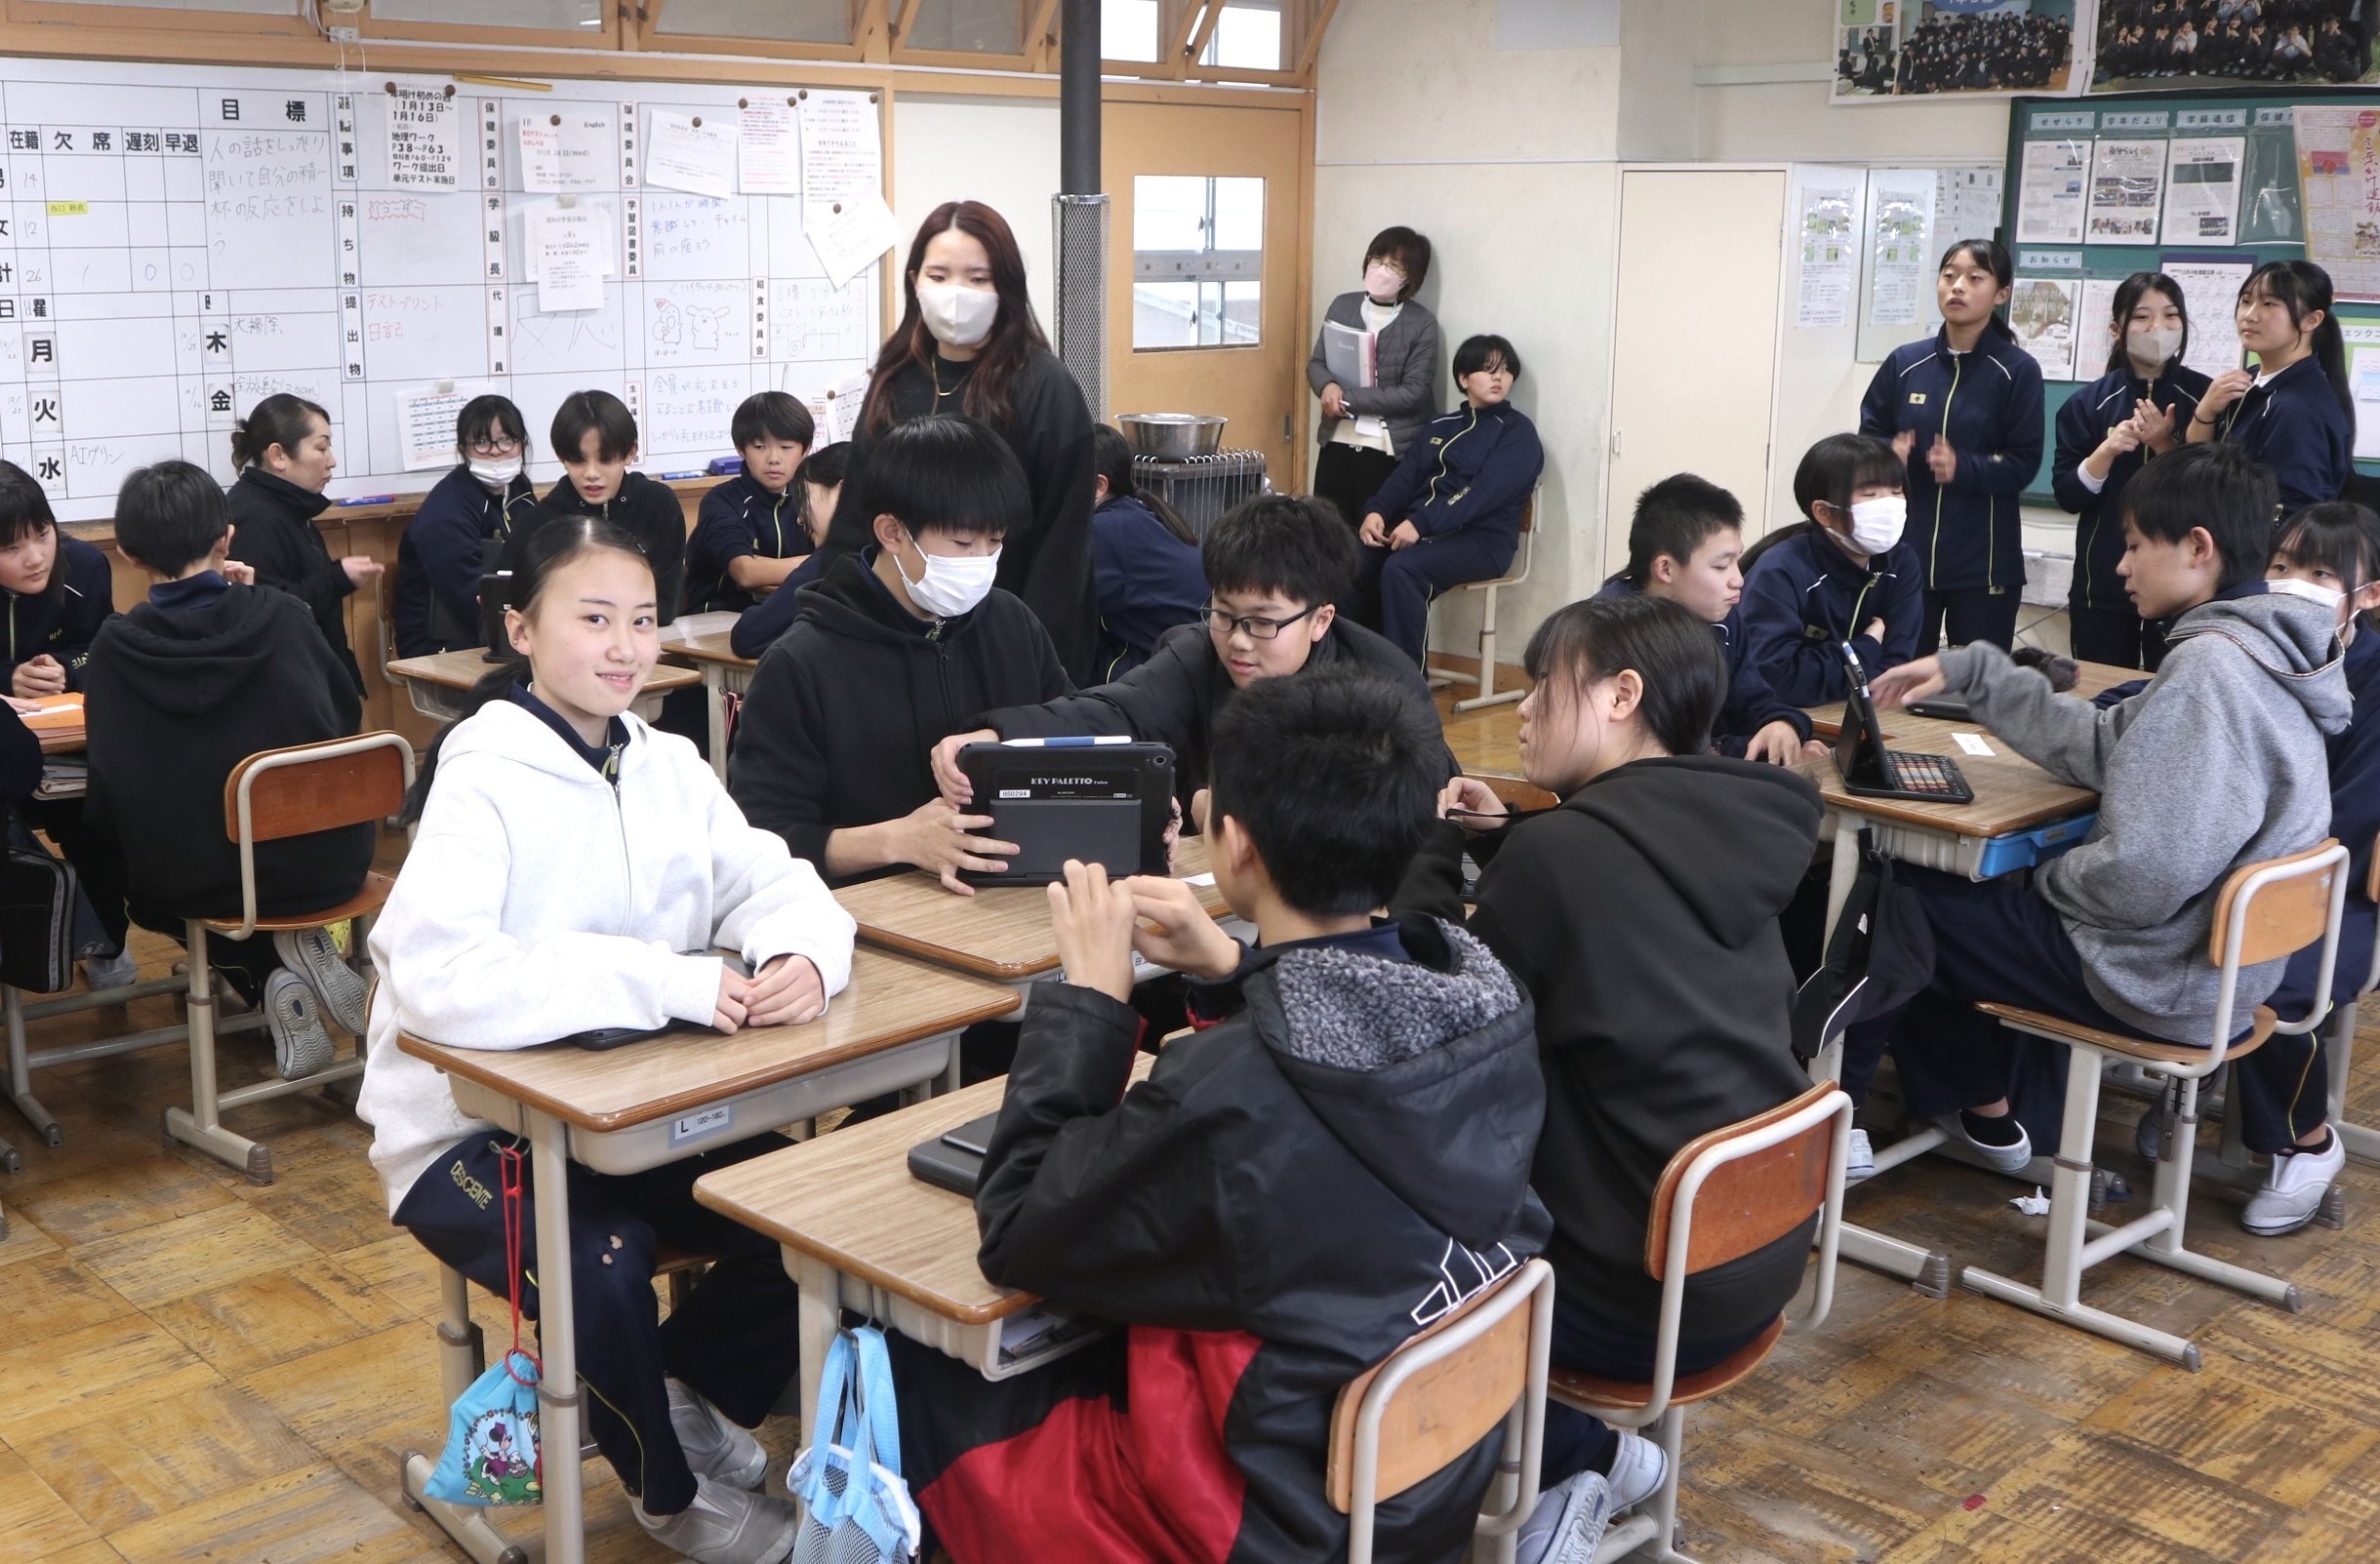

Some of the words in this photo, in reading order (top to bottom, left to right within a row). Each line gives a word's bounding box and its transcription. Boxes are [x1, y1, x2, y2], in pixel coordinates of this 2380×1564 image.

[222, 99, 305, 122] 目標
[2107, 114, 2163, 126] 学年だより
[2187, 113, 2237, 125] 学級通信
[584, 121, 606, 130] English
[2039, 117, 2084, 128] せせらぎ
[10, 130, 40, 150] 在籍
[54, 131, 111, 151] 欠席
[125, 132, 160, 153] 遅刻
[165, 133, 199, 153] 早退
[391, 132, 435, 142] 地理ワーク
[484, 102, 497, 186] 保健委員会
[623, 104, 634, 185] 環境委員会
[392, 162, 446, 173] ワーク提出日
[24, 173, 37, 188] 14
[24, 220, 37, 238] 12
[489, 198, 501, 276] 学級長
[627, 200, 637, 276] 学習図書委員
[341, 204, 356, 286] 持ち物
[2030, 255, 2072, 265] お知らせ
[26, 266, 42, 283] 26
[366, 293, 445, 312] テストプリント
[755, 279, 765, 355] 給食委員会
[344, 296, 361, 377] 提出物
[369, 321, 403, 342] 日記
[492, 290, 504, 372] 代議員
[30, 339, 54, 363] 月
[206, 331, 227, 353] 木
[33, 398, 58, 422] 火
[210, 390, 231, 411] 金
[38, 457, 61, 480] 水
[1030, 777, 1050, 785] KEY
[1052, 777, 1093, 785] PALETTO
[681, 1120, 689, 1134] L
[450, 1159, 493, 1211] DESCENTE
